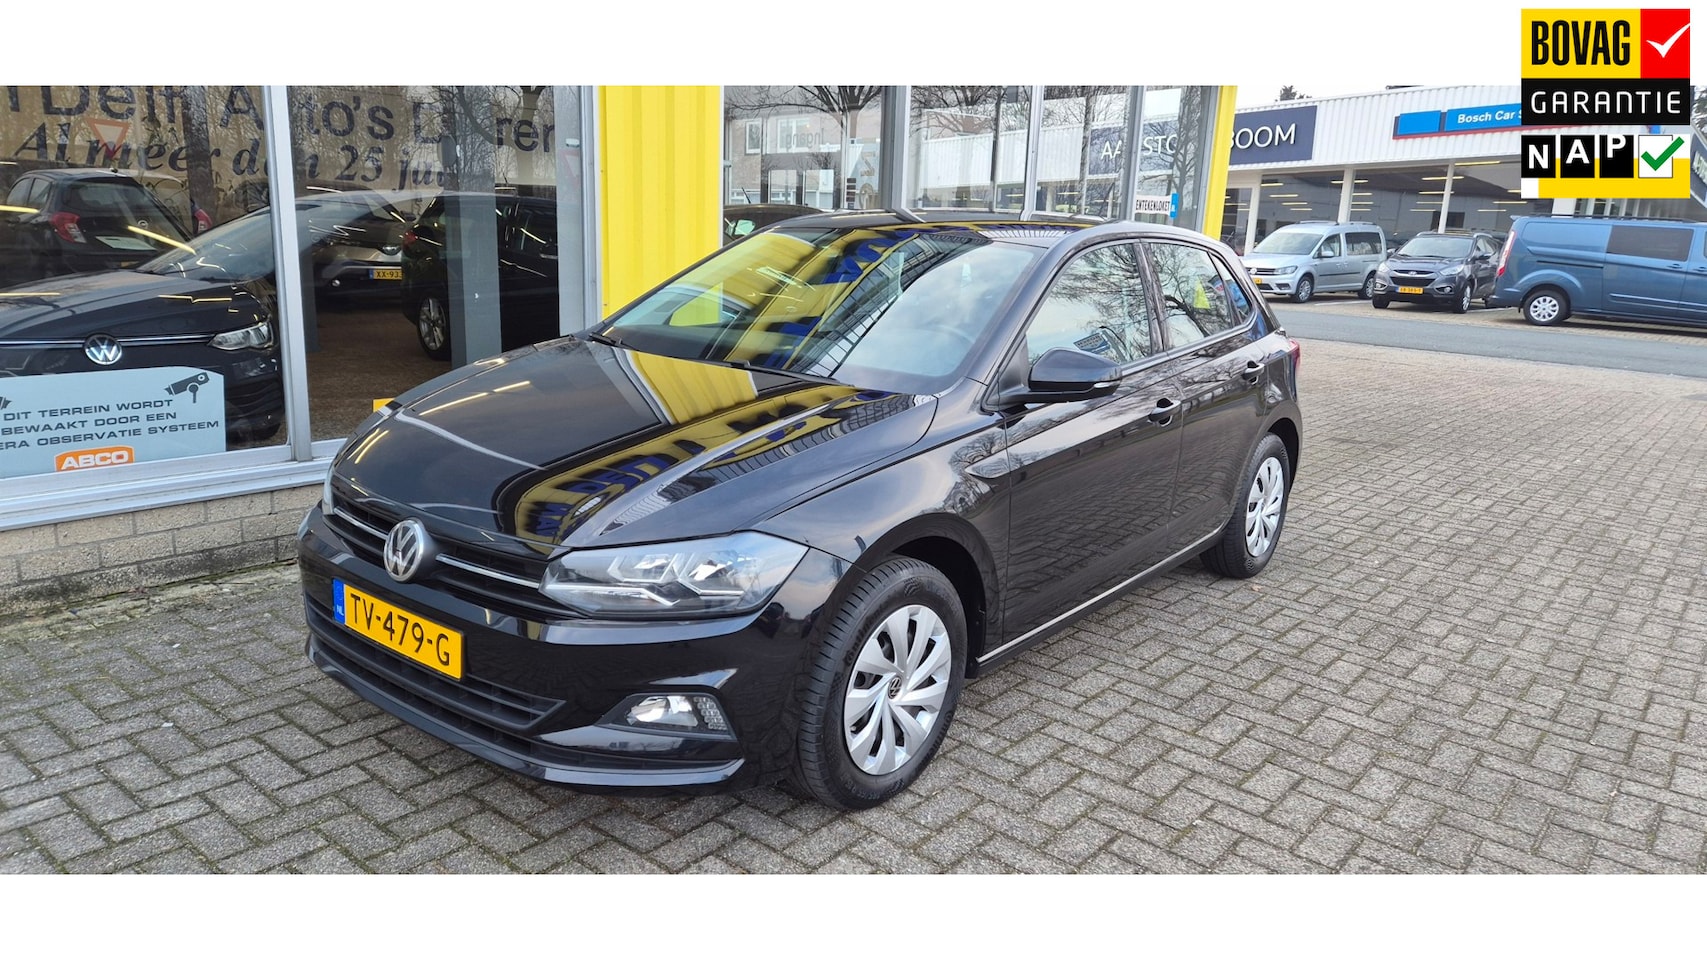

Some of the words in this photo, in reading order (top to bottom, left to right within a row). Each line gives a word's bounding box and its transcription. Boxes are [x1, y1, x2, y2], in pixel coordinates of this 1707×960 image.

[220, 86, 394, 141] Ato's
[1457, 112, 1492, 124] Bosch
[1495, 110, 1516, 121] Car
[335, 144, 383, 182] 25
[4, 411, 32, 421] DIT
[38, 404, 110, 418] TERREIN
[116, 399, 173, 411] WORDT
[1, 420, 88, 436] BEWAAKT
[95, 415, 140, 427] DOOR
[146, 412, 177, 422] EEN
[37, 428, 142, 446] OBSERVATIE
[148, 420, 219, 435] SYSTEEM
[61, 450, 129, 470] ABCO
[336, 604, 345, 617] NL
[350, 592, 451, 667] TV-479-G
